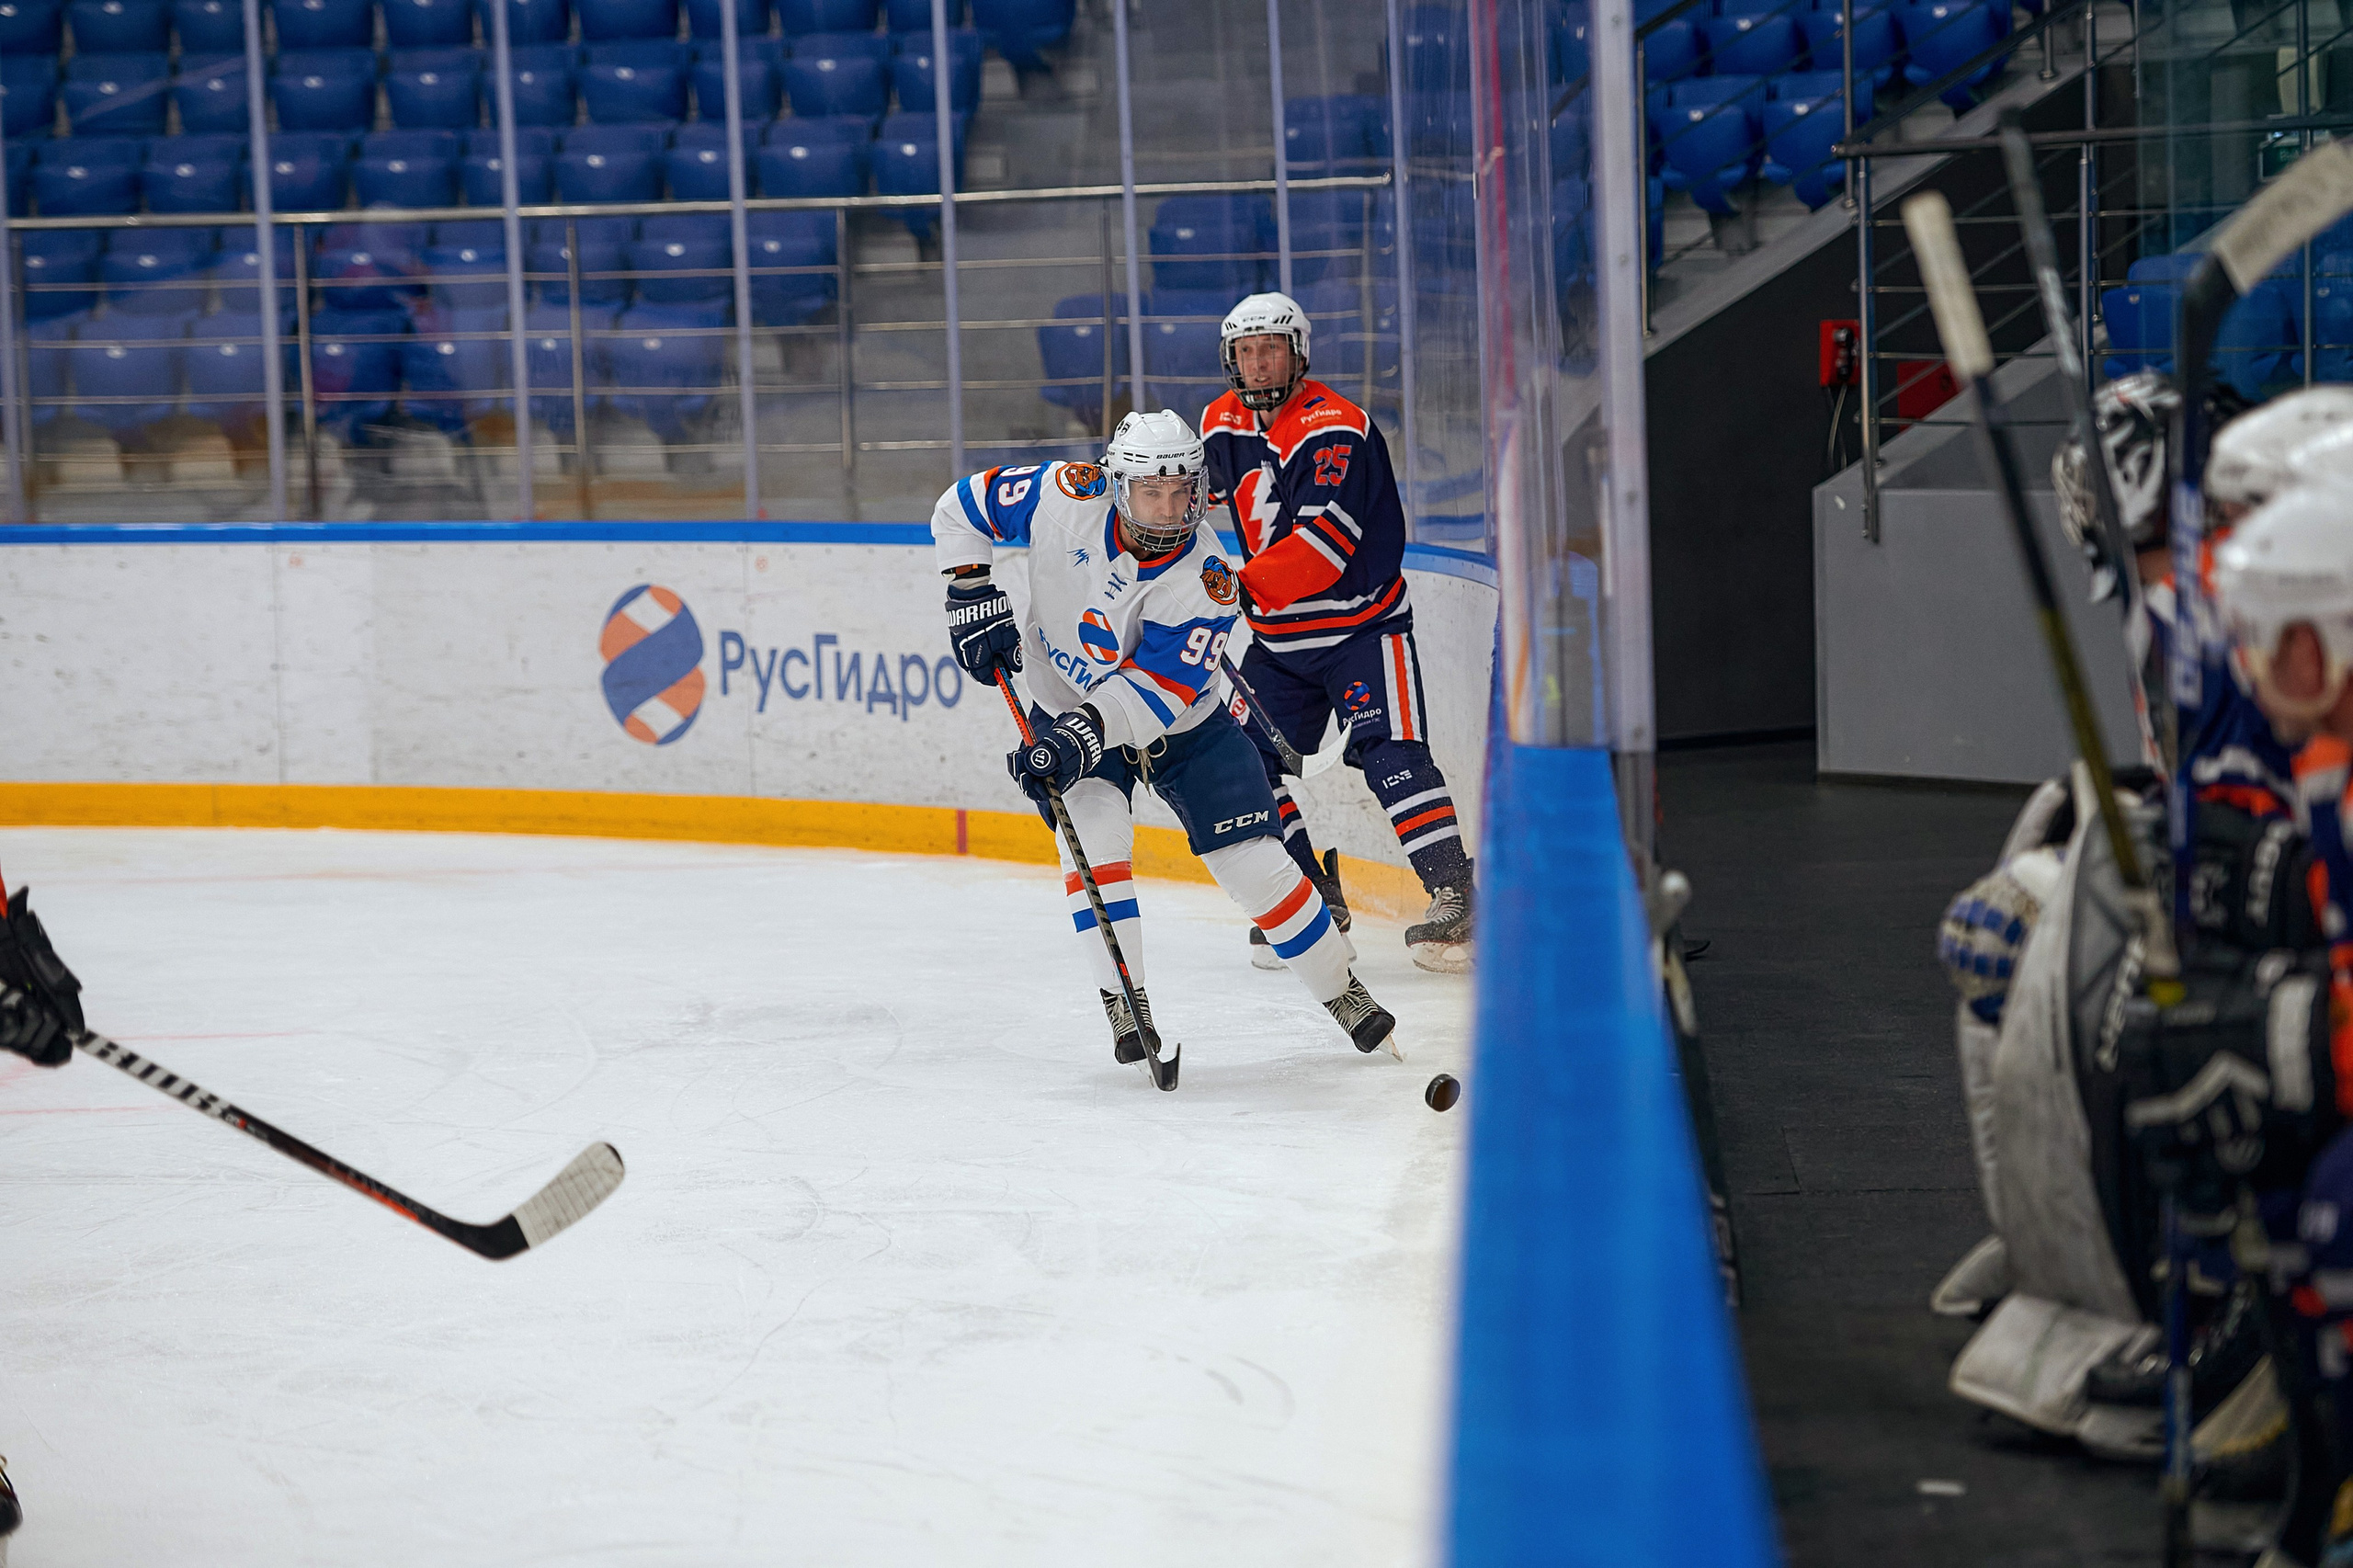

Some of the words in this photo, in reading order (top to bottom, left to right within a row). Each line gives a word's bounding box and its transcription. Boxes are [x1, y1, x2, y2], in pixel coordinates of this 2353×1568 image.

[1301, 408, 1343, 425] РусГидро
[1313, 444, 1352, 486] 25
[1179, 626, 1229, 672] 99
[718, 631, 962, 722] РусГидро
[1213, 810, 1269, 835] CCM
